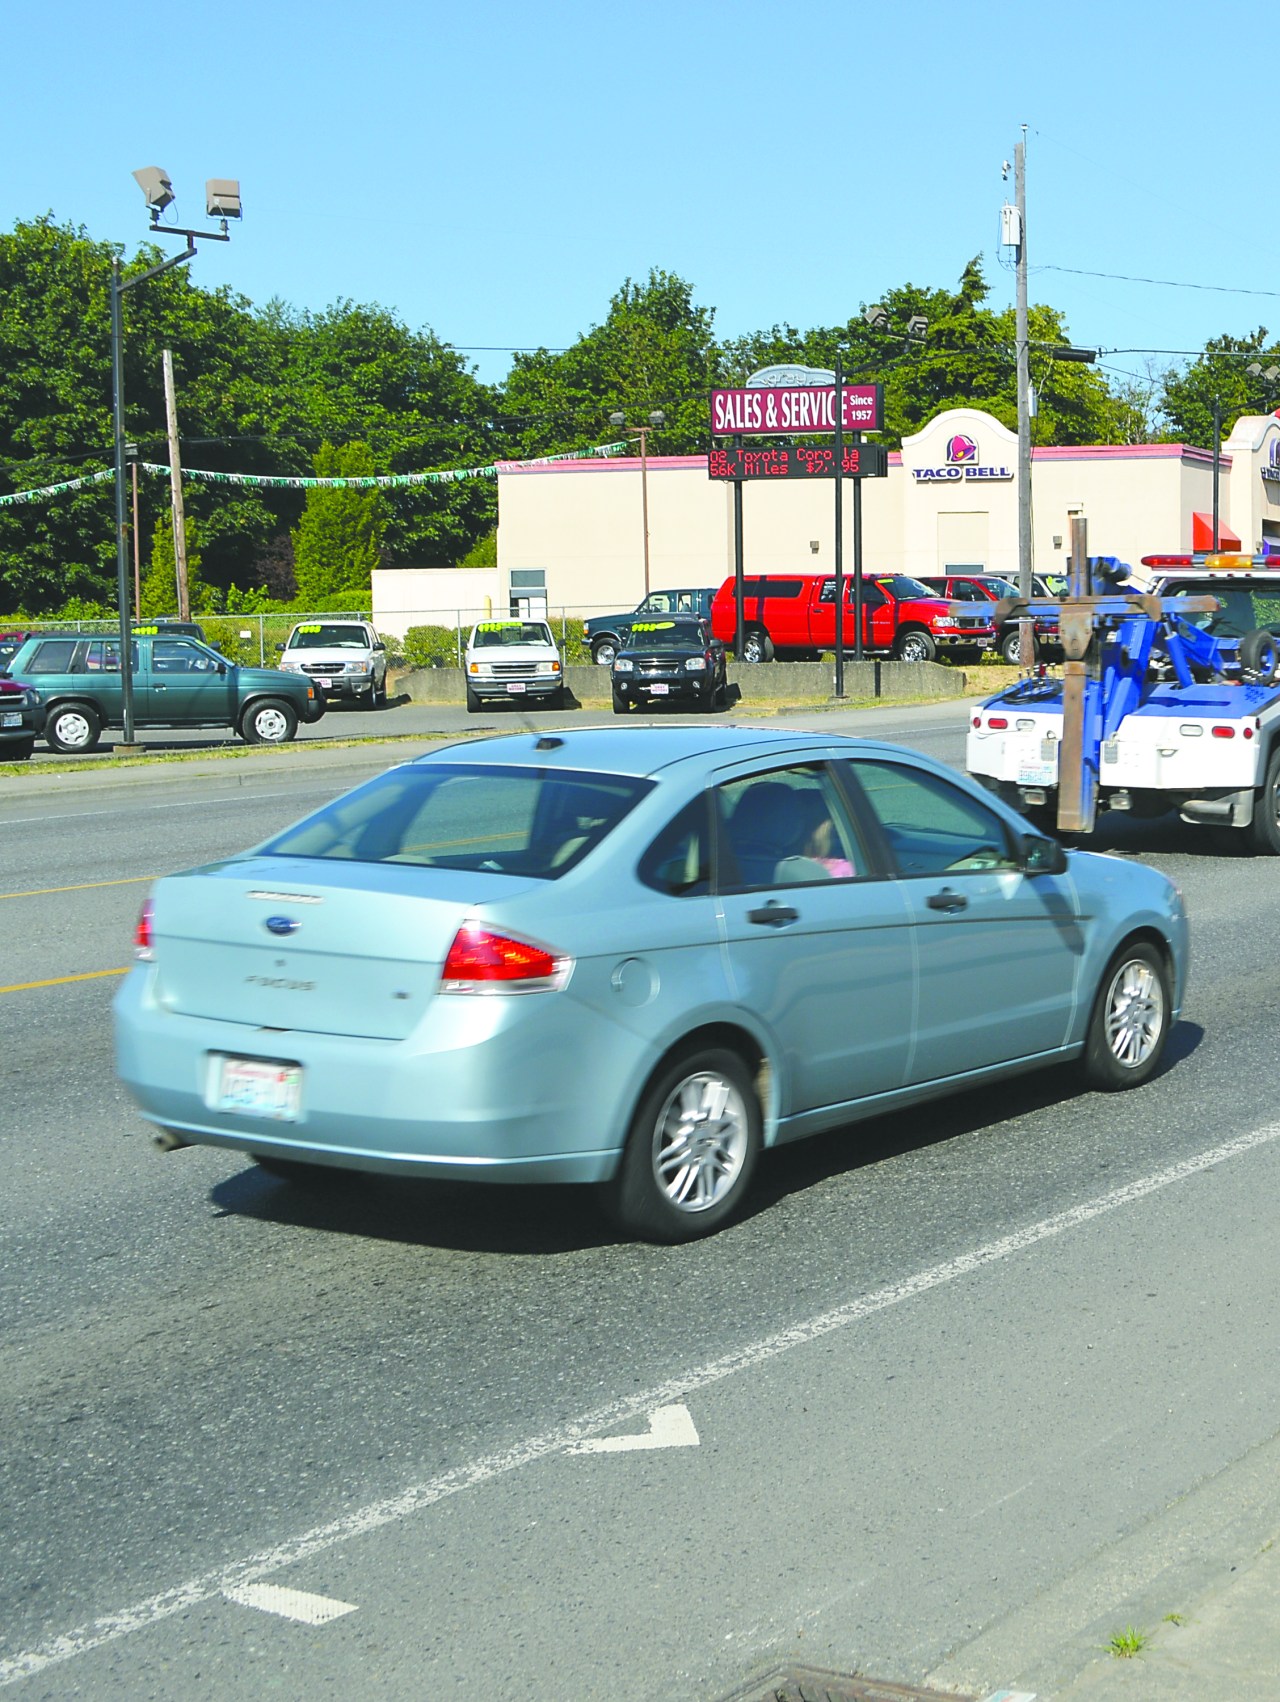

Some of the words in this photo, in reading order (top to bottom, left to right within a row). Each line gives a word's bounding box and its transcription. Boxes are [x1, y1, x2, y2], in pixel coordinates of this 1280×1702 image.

[850, 395, 873, 406] Since
[715, 393, 762, 430] SALES
[765, 393, 778, 428] &
[781, 390, 848, 427] SERVICE
[851, 410, 872, 421] 1957
[736, 449, 789, 464] Toyota
[796, 447, 860, 464] Corola
[709, 463, 736, 477] 56K
[744, 462, 789, 475] Miles
[805, 460, 860, 474] $7,95
[913, 468, 960, 478] TACO
[965, 467, 1011, 477] BELL
